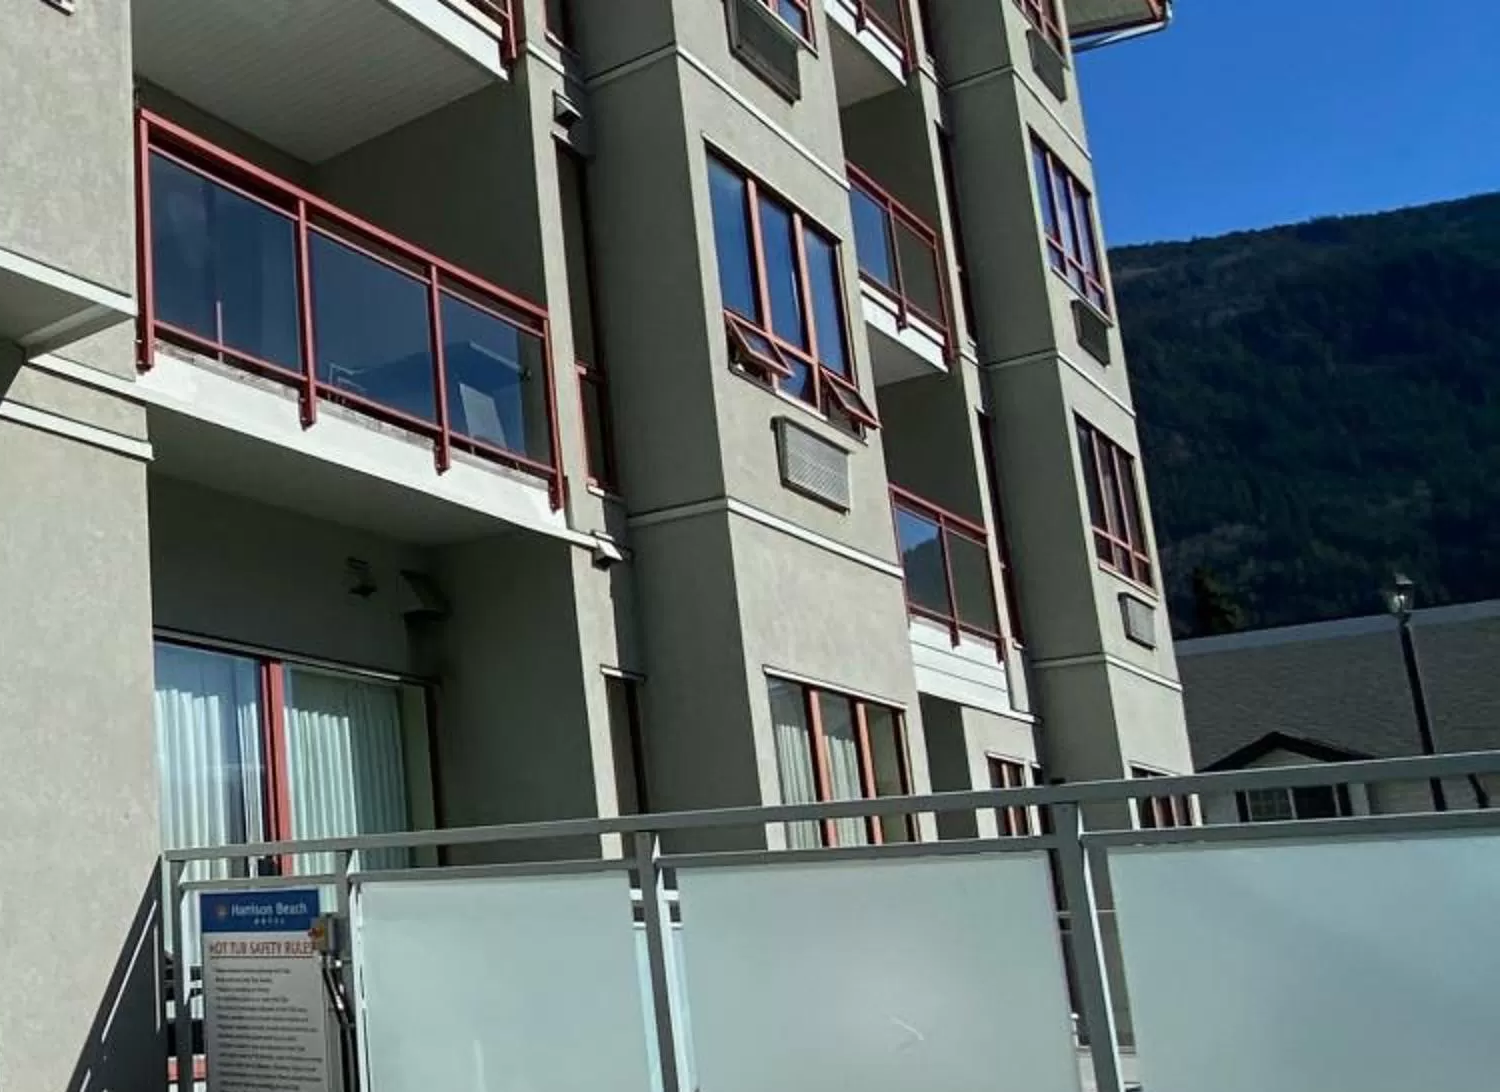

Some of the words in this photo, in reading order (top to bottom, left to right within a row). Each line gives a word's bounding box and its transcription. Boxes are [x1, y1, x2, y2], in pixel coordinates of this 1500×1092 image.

[231, 904, 273, 916] Harrison
[276, 902, 308, 914] Beach
[250, 941, 283, 954] SAFETY
